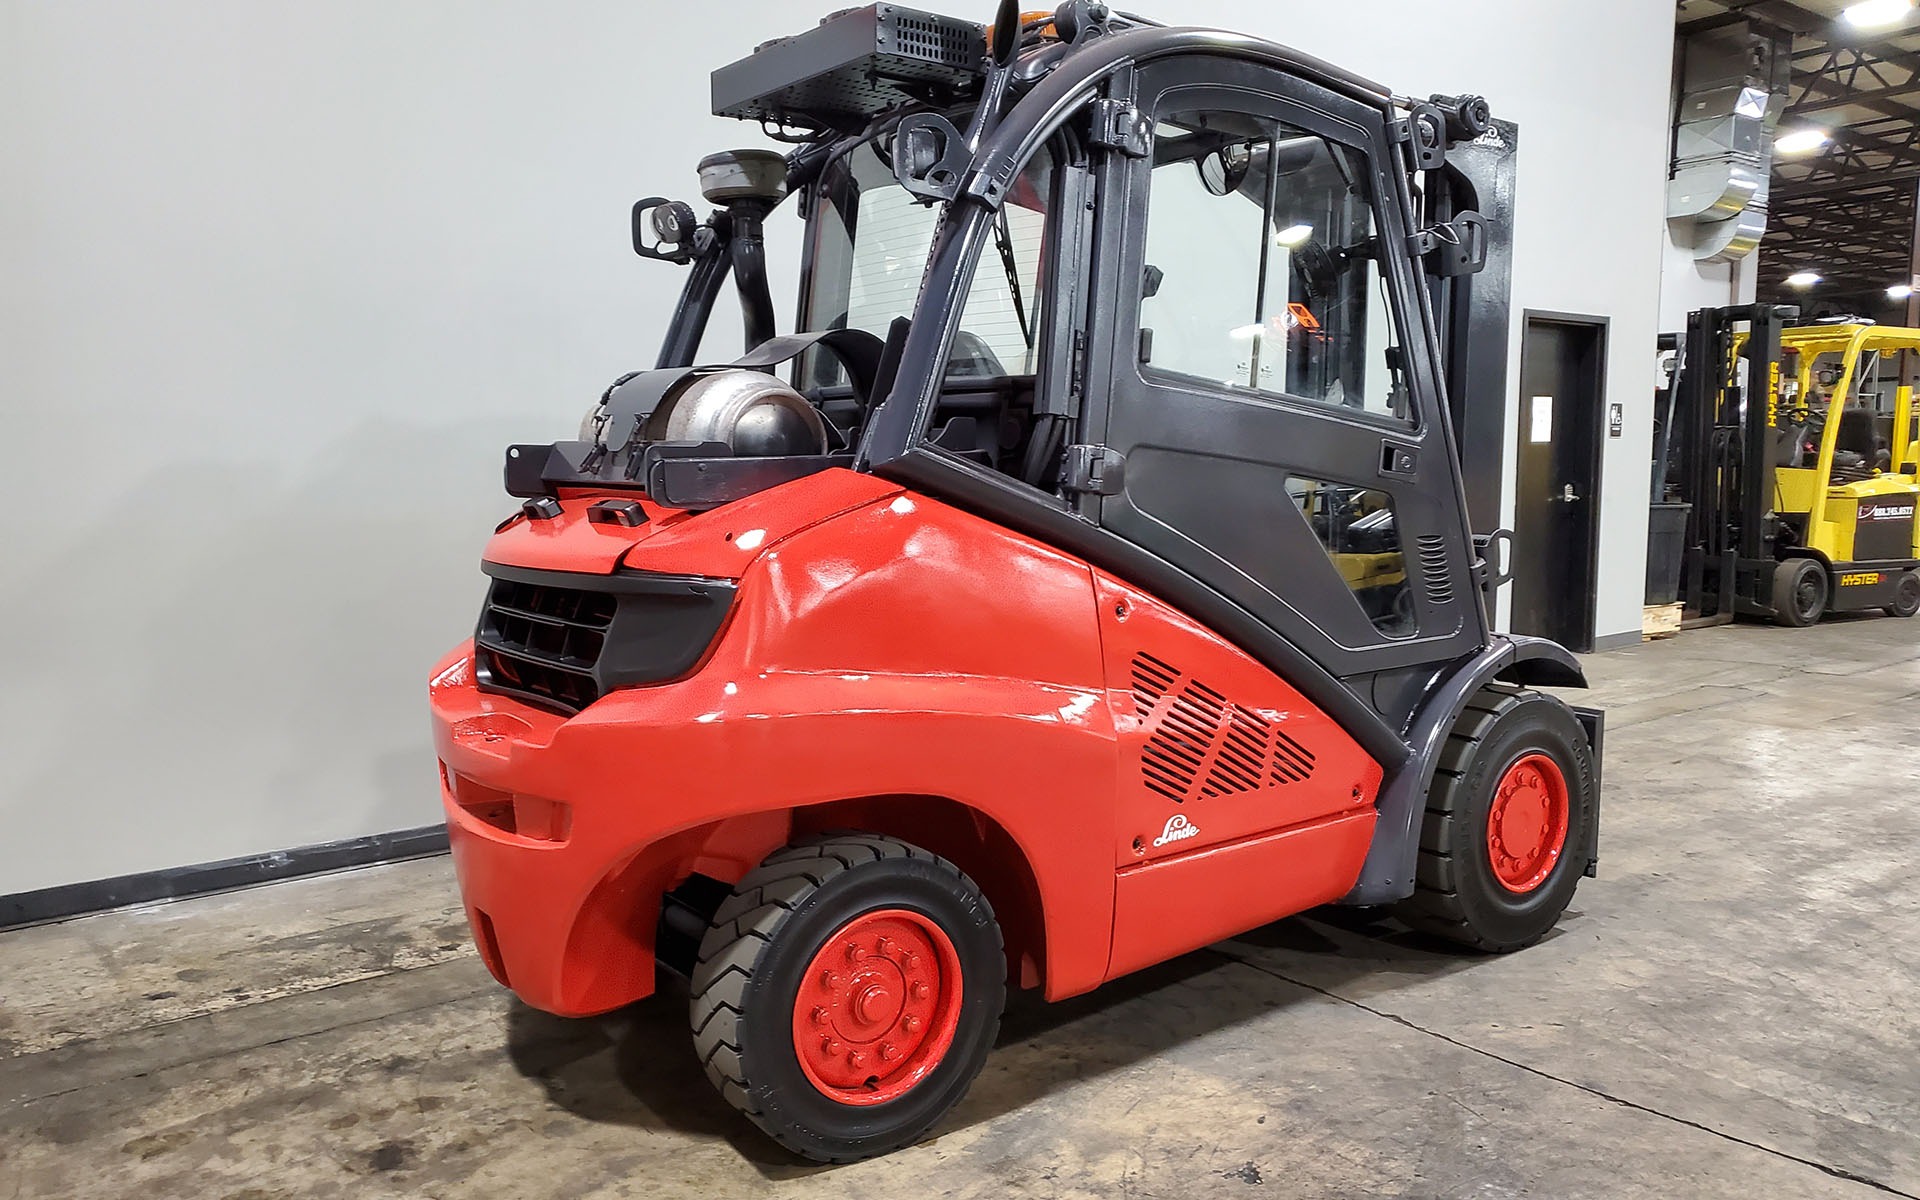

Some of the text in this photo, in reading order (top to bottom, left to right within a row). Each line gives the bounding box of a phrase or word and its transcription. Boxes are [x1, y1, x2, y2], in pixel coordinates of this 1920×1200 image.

[1473, 125, 1506, 148] Linde
[1767, 361, 1779, 428] HYSTER
[1841, 572, 1879, 587] HYSTER
[1153, 814, 1200, 847] Linde
